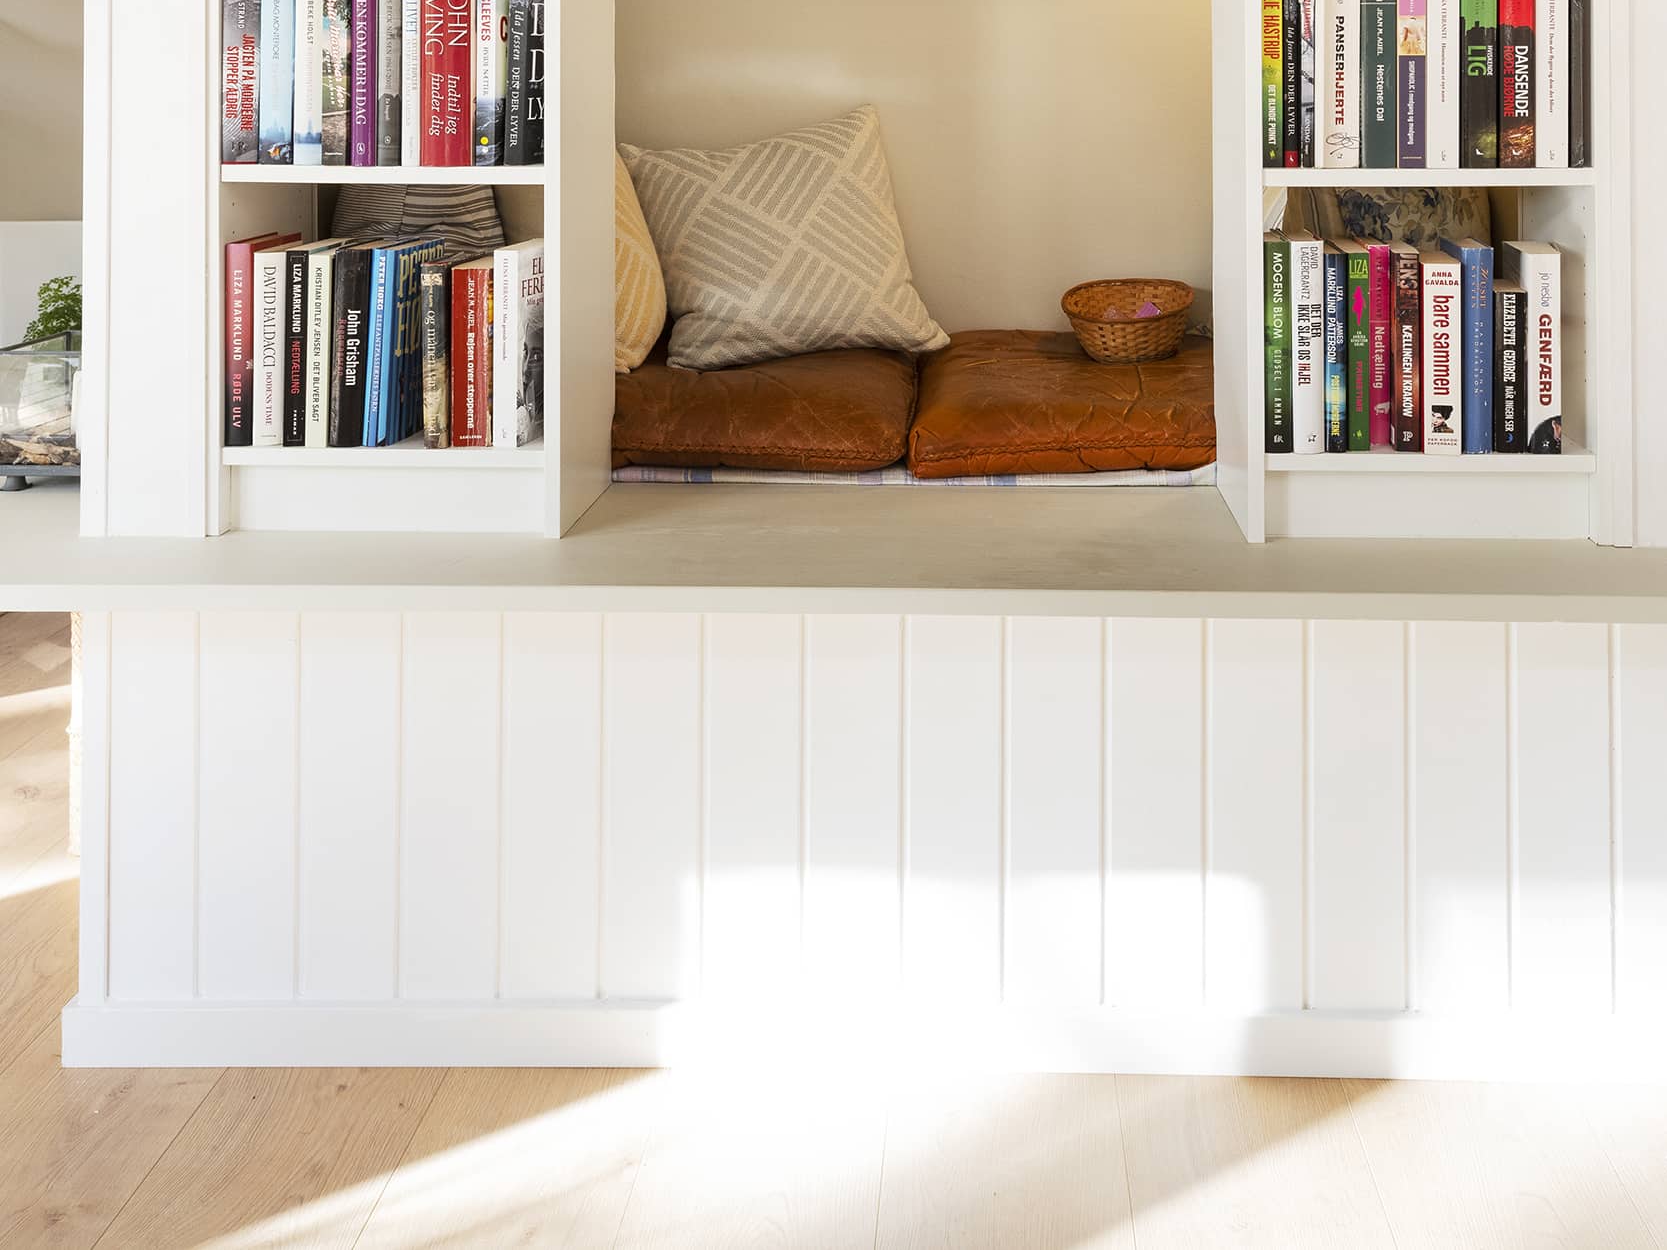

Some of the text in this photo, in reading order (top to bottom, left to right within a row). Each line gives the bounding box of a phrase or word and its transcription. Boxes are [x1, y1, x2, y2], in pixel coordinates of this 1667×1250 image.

[237, 2, 246, 29] STRAND
[272, 16, 281, 60] MONTEFIORE
[306, 22, 314, 45] HOLST
[406, 2, 418, 34] LIVET
[1263, 15, 1280, 59] HASTRUP
[1287, 27, 1295, 60] Ida Jessen
[1376, 8, 1385, 56] JEAN AUEL
[241, 33, 256, 131] JAGTEN PÅ MORDERNE
[355, 21, 367, 85] KOMMER
[509, 10, 524, 147] Ida Jessen DEN DER LYVER
[1335, 16, 1345, 126] PANSERHJERTE
[1467, 45, 1488, 76] LIG
[1503, 45, 1515, 117] RØDE BJØRNE
[1514, 45, 1529, 117] DANSENDE
[226, 46, 239, 119] STOPPER ALDRIG
[355, 97, 367, 125] DAG
[429, 73, 445, 136] finder dig
[445, 74, 461, 135] Indtil jeg
[1287, 63, 1295, 136] DEN DER LYVER
[1376, 64, 1386, 121] Hestenes Dal
[1268, 84, 1277, 145] DET BLINDE PUNKT
[1300, 247, 1310, 299] LAGERCRANTZ
[1310, 247, 1319, 269] DAVID
[1350, 260, 1368, 274] LIZA
[1400, 253, 1419, 310] JENSEN
[232, 270, 244, 361] LIZA MARKLUND
[261, 266, 277, 367] DAVID BALDACCI
[291, 264, 303, 333] LIZA MARKLUND
[313, 267, 323, 356] KRISTIAN DITLEV JENSEN
[467, 278, 477, 329] JEAN AUEL
[1327, 267, 1337, 314] MARKLUND
[1336, 286, 1344, 301] LIZA
[1541, 283, 1552, 307] nesbø
[345, 309, 362, 386] John Grisham
[373, 256, 387, 389] PETER HØEG ELEFANTPASSERNES
[425, 310, 439, 367] og månen
[1273, 252, 1284, 425] MOGENS BLOM GIDSEL AMMAN
[1298, 304, 1312, 386] IKKE SLÅR OS IHJEL
[1310, 304, 1322, 338] DET DER
[1327, 317, 1337, 363] PATTERSON
[1336, 320, 1344, 344] JAMES
[1432, 295, 1454, 395] bare sammen
[1503, 294, 1516, 382] ELIZABETH GEORGE
[290, 341, 301, 395] NEDTÆLLING
[466, 333, 477, 429] Rejsen over stepperne
[1373, 326, 1386, 388] Nedtælling
[1402, 325, 1414, 418] KÆLLINGEN KRAKÓW
[1539, 314, 1552, 406] GENFÆRD
[232, 374, 242, 428] RØDE ULV
[264, 407, 273, 425] TIME
[312, 362, 321, 422] DET BLIVER SAGT
[1504, 421, 1514, 431] SER
